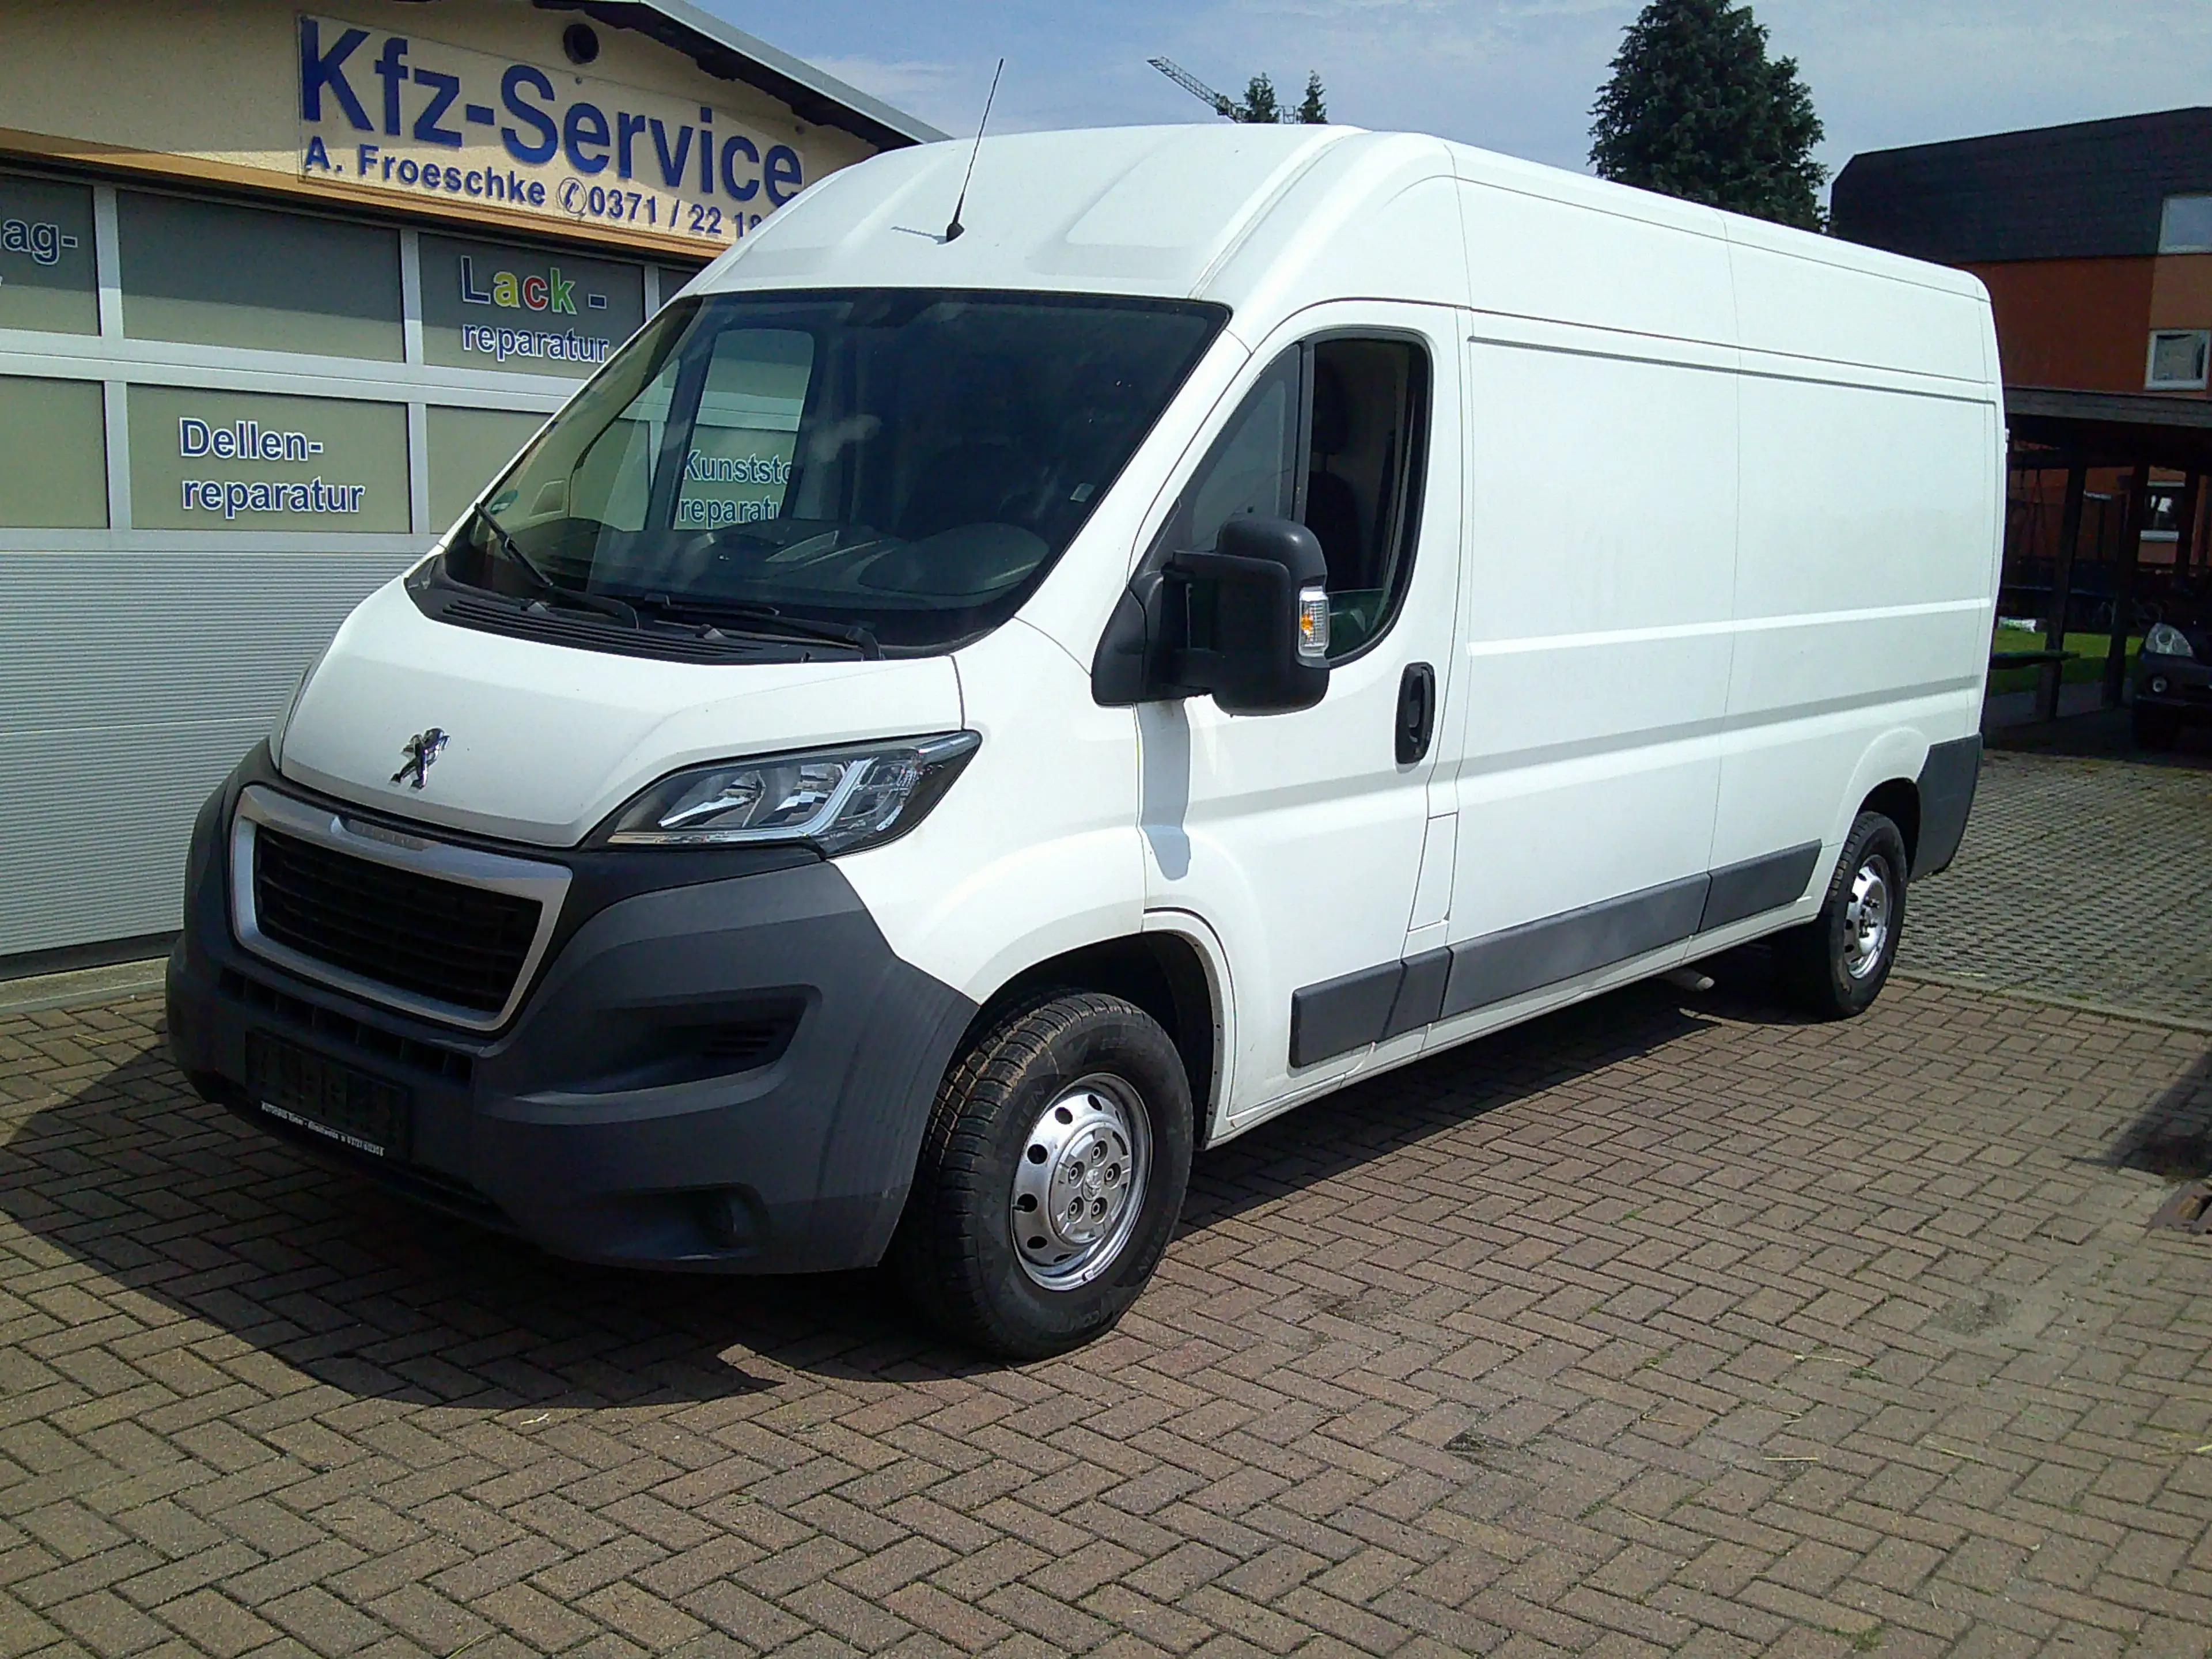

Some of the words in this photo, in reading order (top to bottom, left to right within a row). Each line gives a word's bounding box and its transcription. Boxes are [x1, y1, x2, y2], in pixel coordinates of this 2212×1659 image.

[301, 17, 802, 208] Kfz-Service
[305, 135, 343, 173] A.
[357, 144, 547, 205] Froeschke
[589, 187, 657, 224] 0371
[690, 203, 722, 234] 22
[0, 219, 78, 266] ag-
[463, 324, 609, 363] reparatur
[179, 417, 324, 461] Dellen-
[181, 476, 366, 519] reparatur
